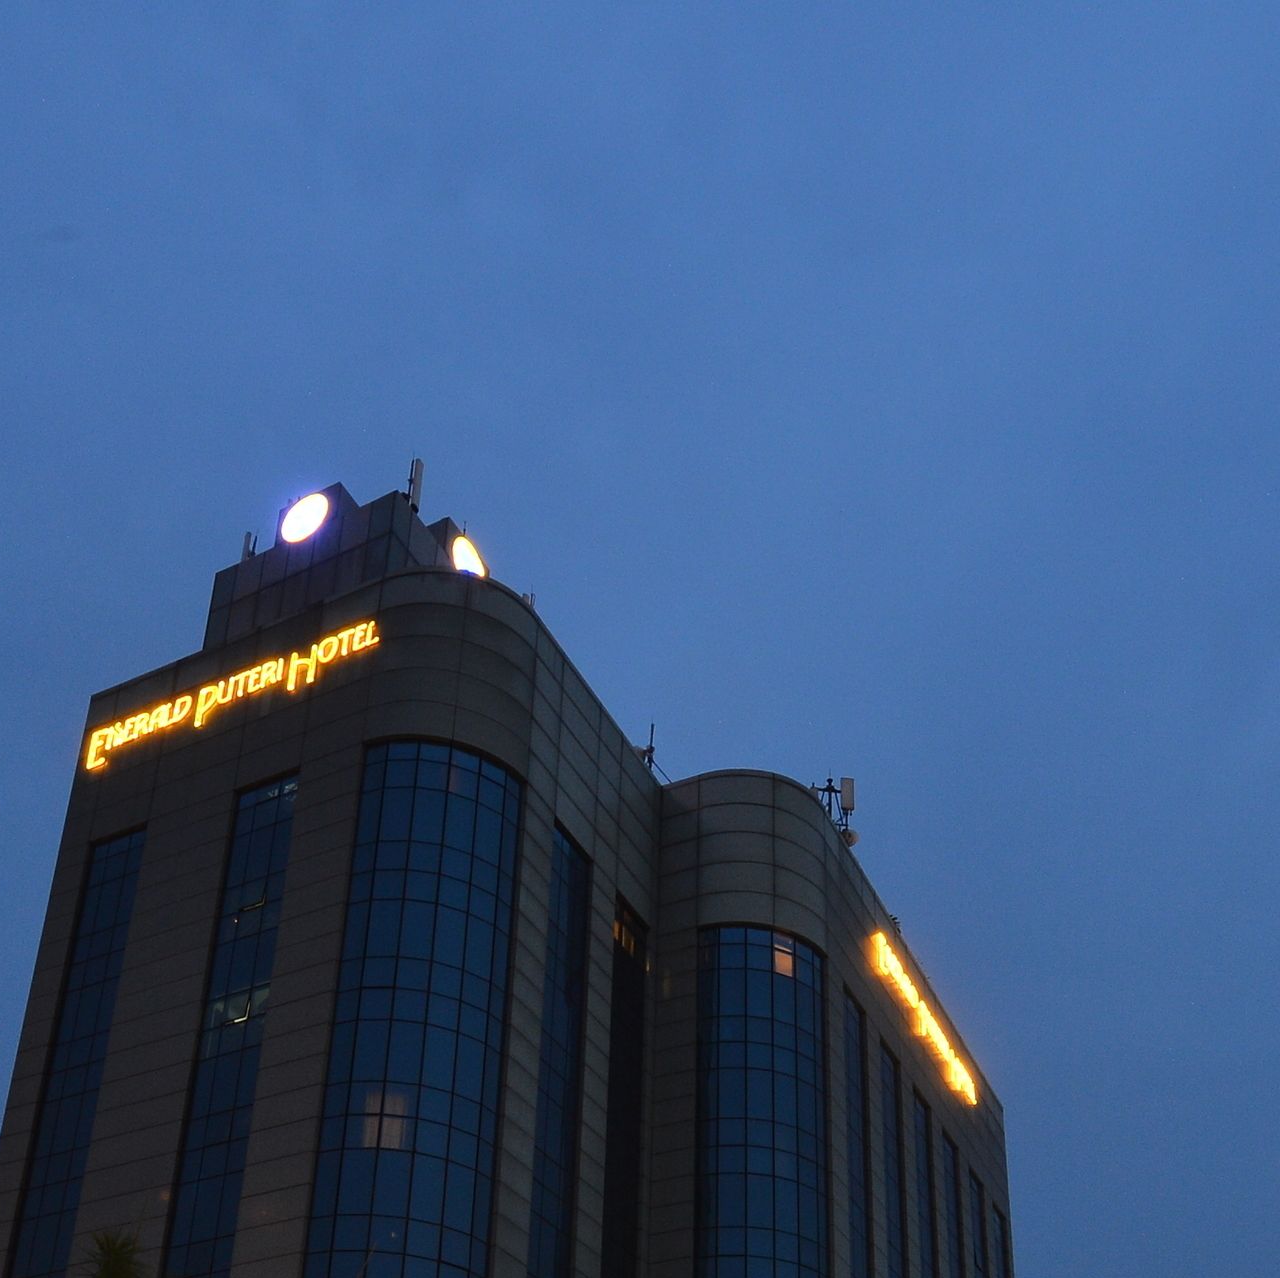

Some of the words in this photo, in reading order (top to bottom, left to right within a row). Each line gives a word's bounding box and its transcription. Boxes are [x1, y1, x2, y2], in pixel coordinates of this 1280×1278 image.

[86, 695, 192, 770] EMERALD
[194, 658, 284, 727] PUTERI
[287, 620, 380, 691] HOTEL
